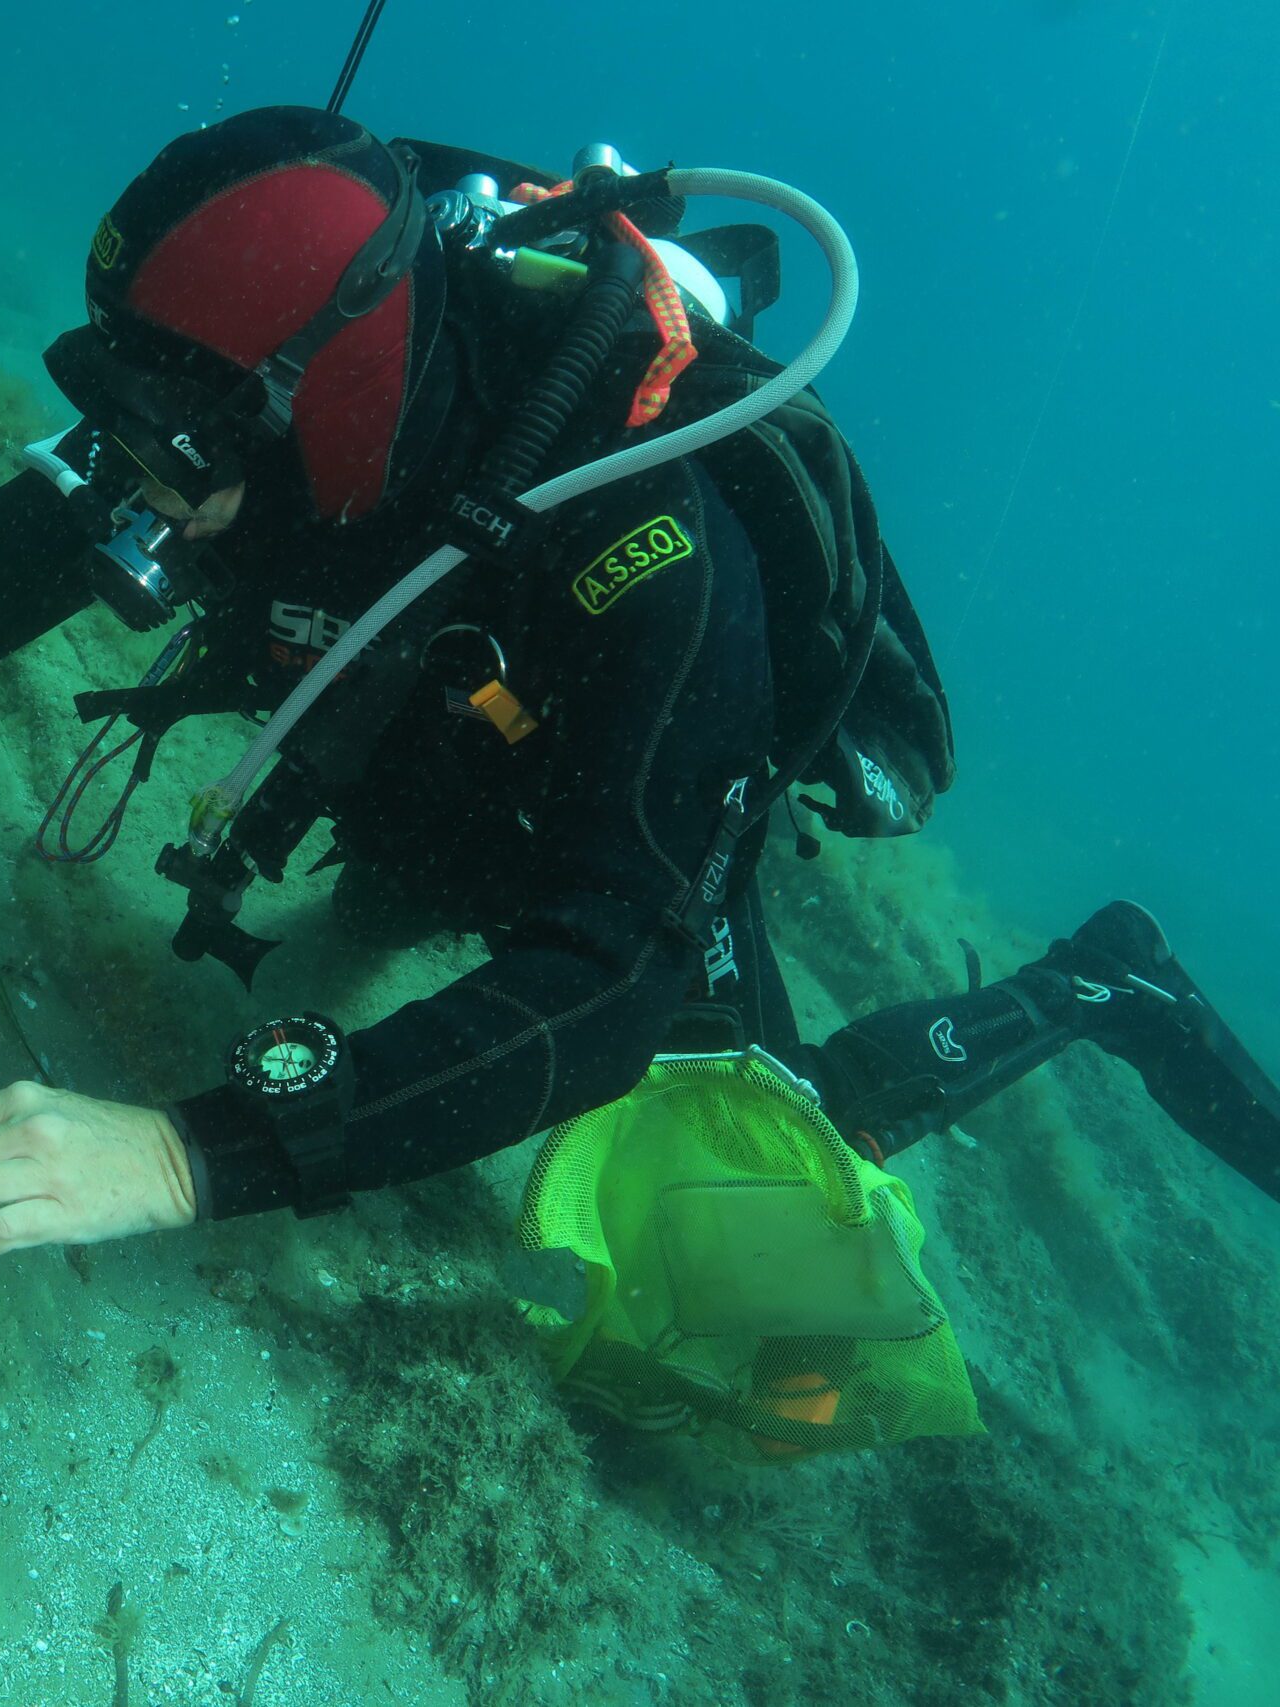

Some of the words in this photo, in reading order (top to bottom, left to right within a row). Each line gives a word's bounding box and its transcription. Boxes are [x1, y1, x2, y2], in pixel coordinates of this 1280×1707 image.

[172, 433, 211, 470] Cressi
[584, 527, 684, 606] A.S.S.O.
[701, 852, 730, 903] TIZIP
[262, 1086, 281, 1094] 330
[288, 1083, 307, 1092] 300
